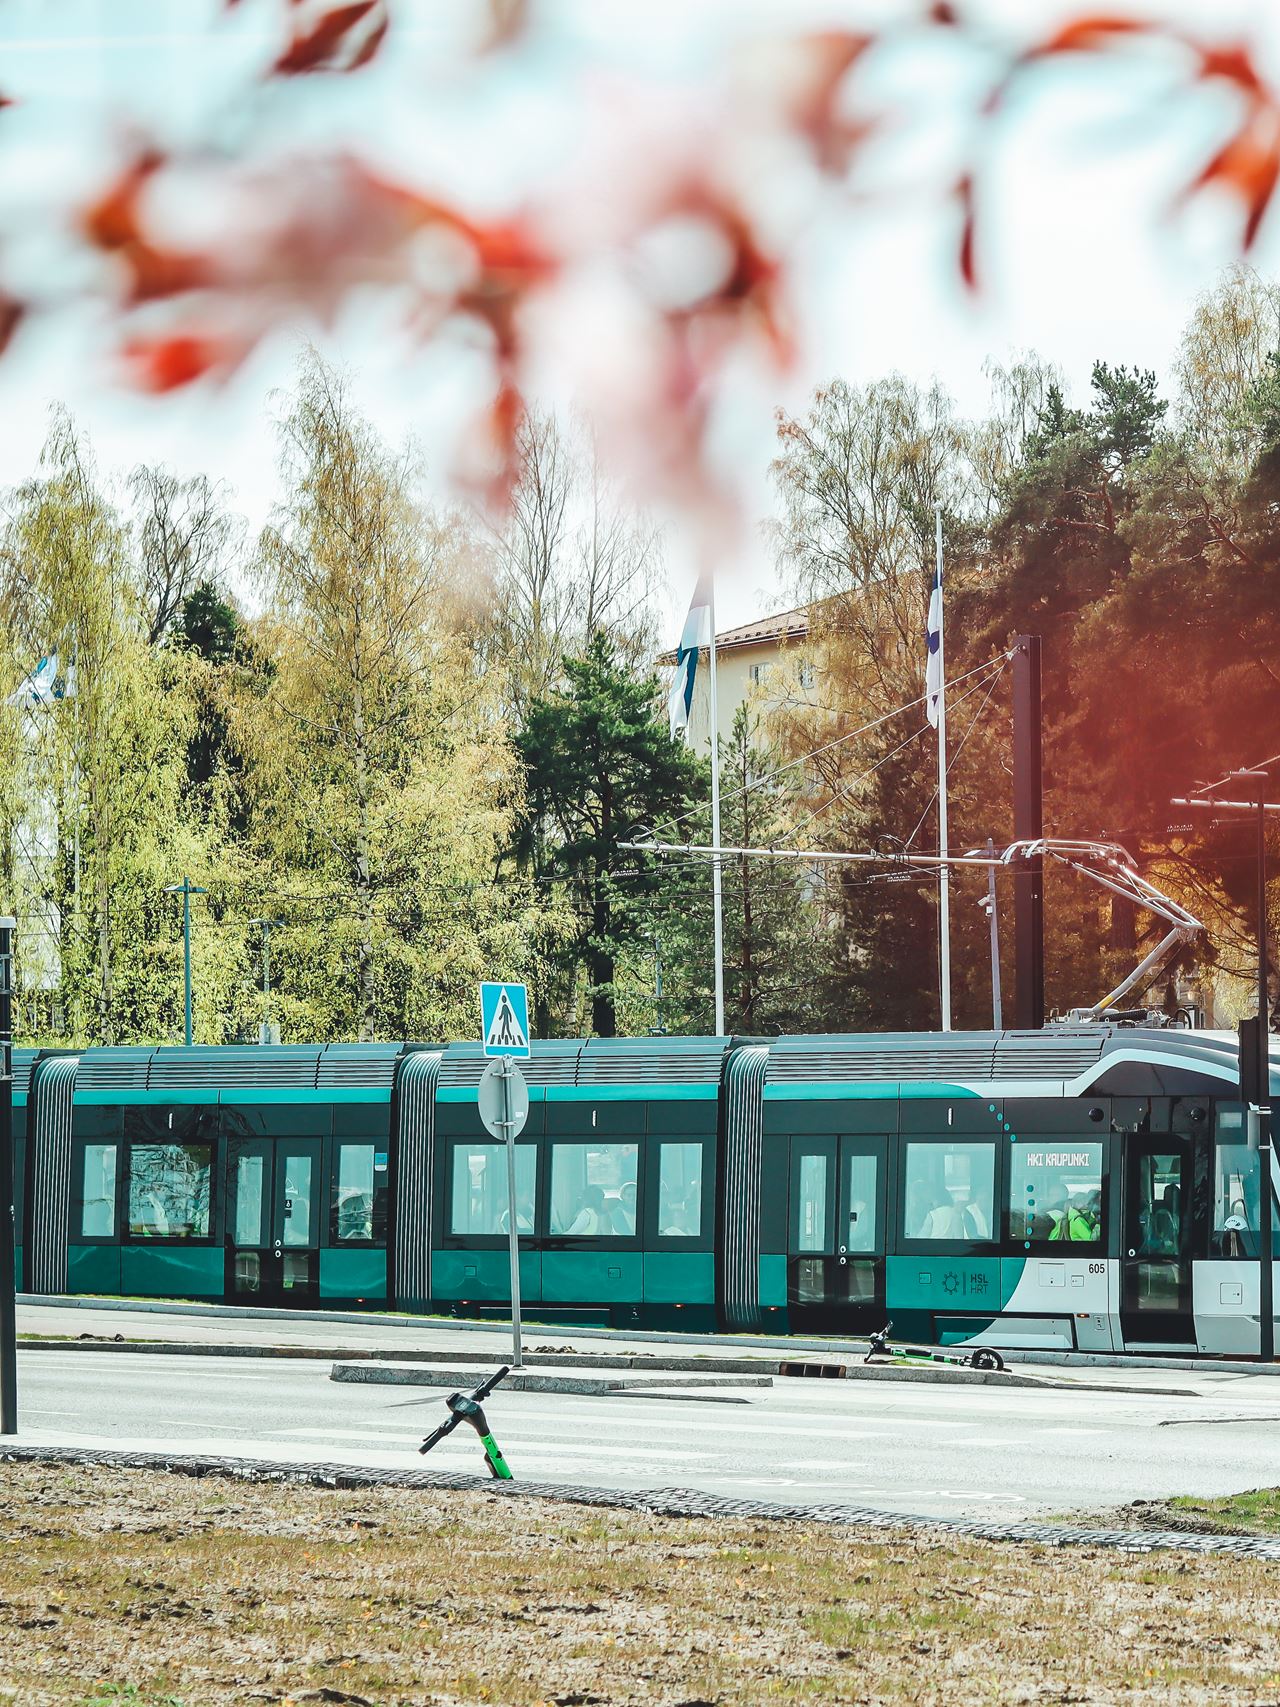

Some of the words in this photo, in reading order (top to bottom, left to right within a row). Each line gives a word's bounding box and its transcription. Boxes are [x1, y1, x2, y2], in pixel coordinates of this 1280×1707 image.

[1027, 1153, 1043, 1166] HKI
[1045, 1153, 1090, 1166] KAUPUNKI
[1088, 1263, 1105, 1274] 605
[970, 1273, 988, 1283] HSL
[970, 1284, 988, 1294] HRT
